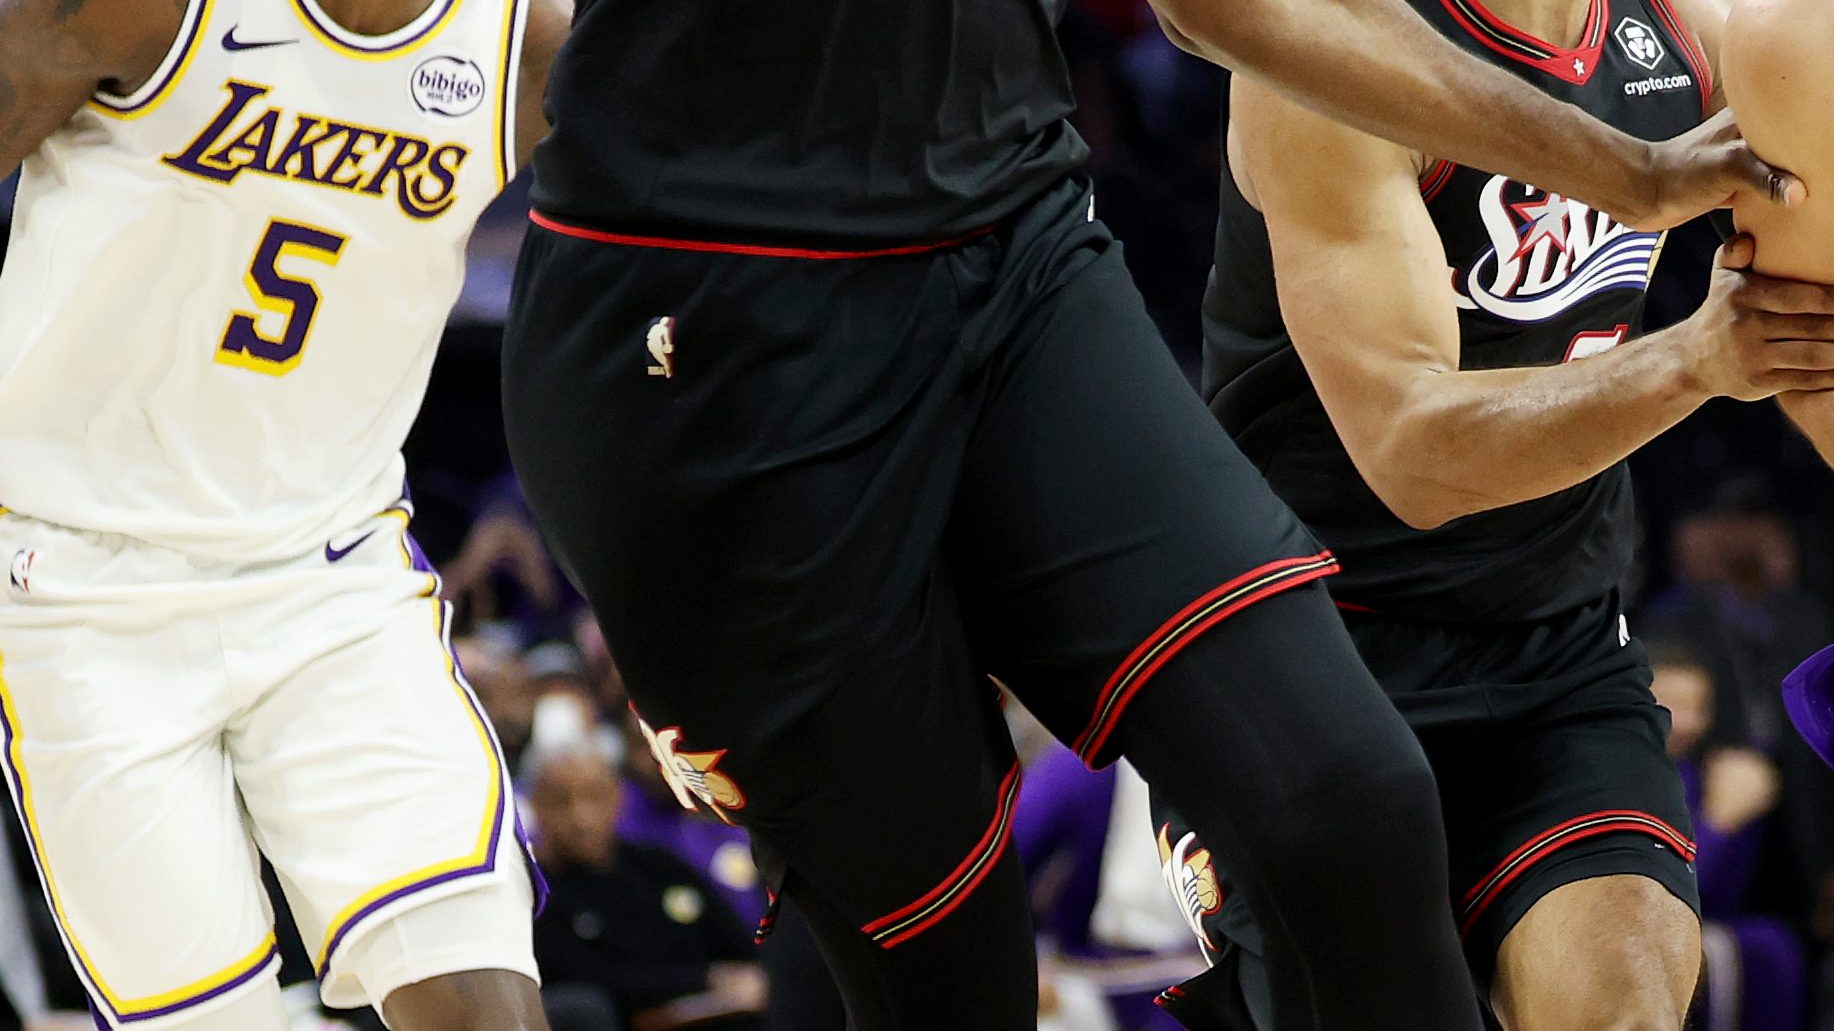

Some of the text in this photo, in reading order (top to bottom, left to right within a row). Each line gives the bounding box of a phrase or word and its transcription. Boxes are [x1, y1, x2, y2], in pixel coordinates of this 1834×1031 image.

[418, 69, 480, 101] bibigo
[1624, 71, 1692, 96] crypto.com
[163, 77, 470, 222] LAKERS
[212, 215, 349, 377] 5
